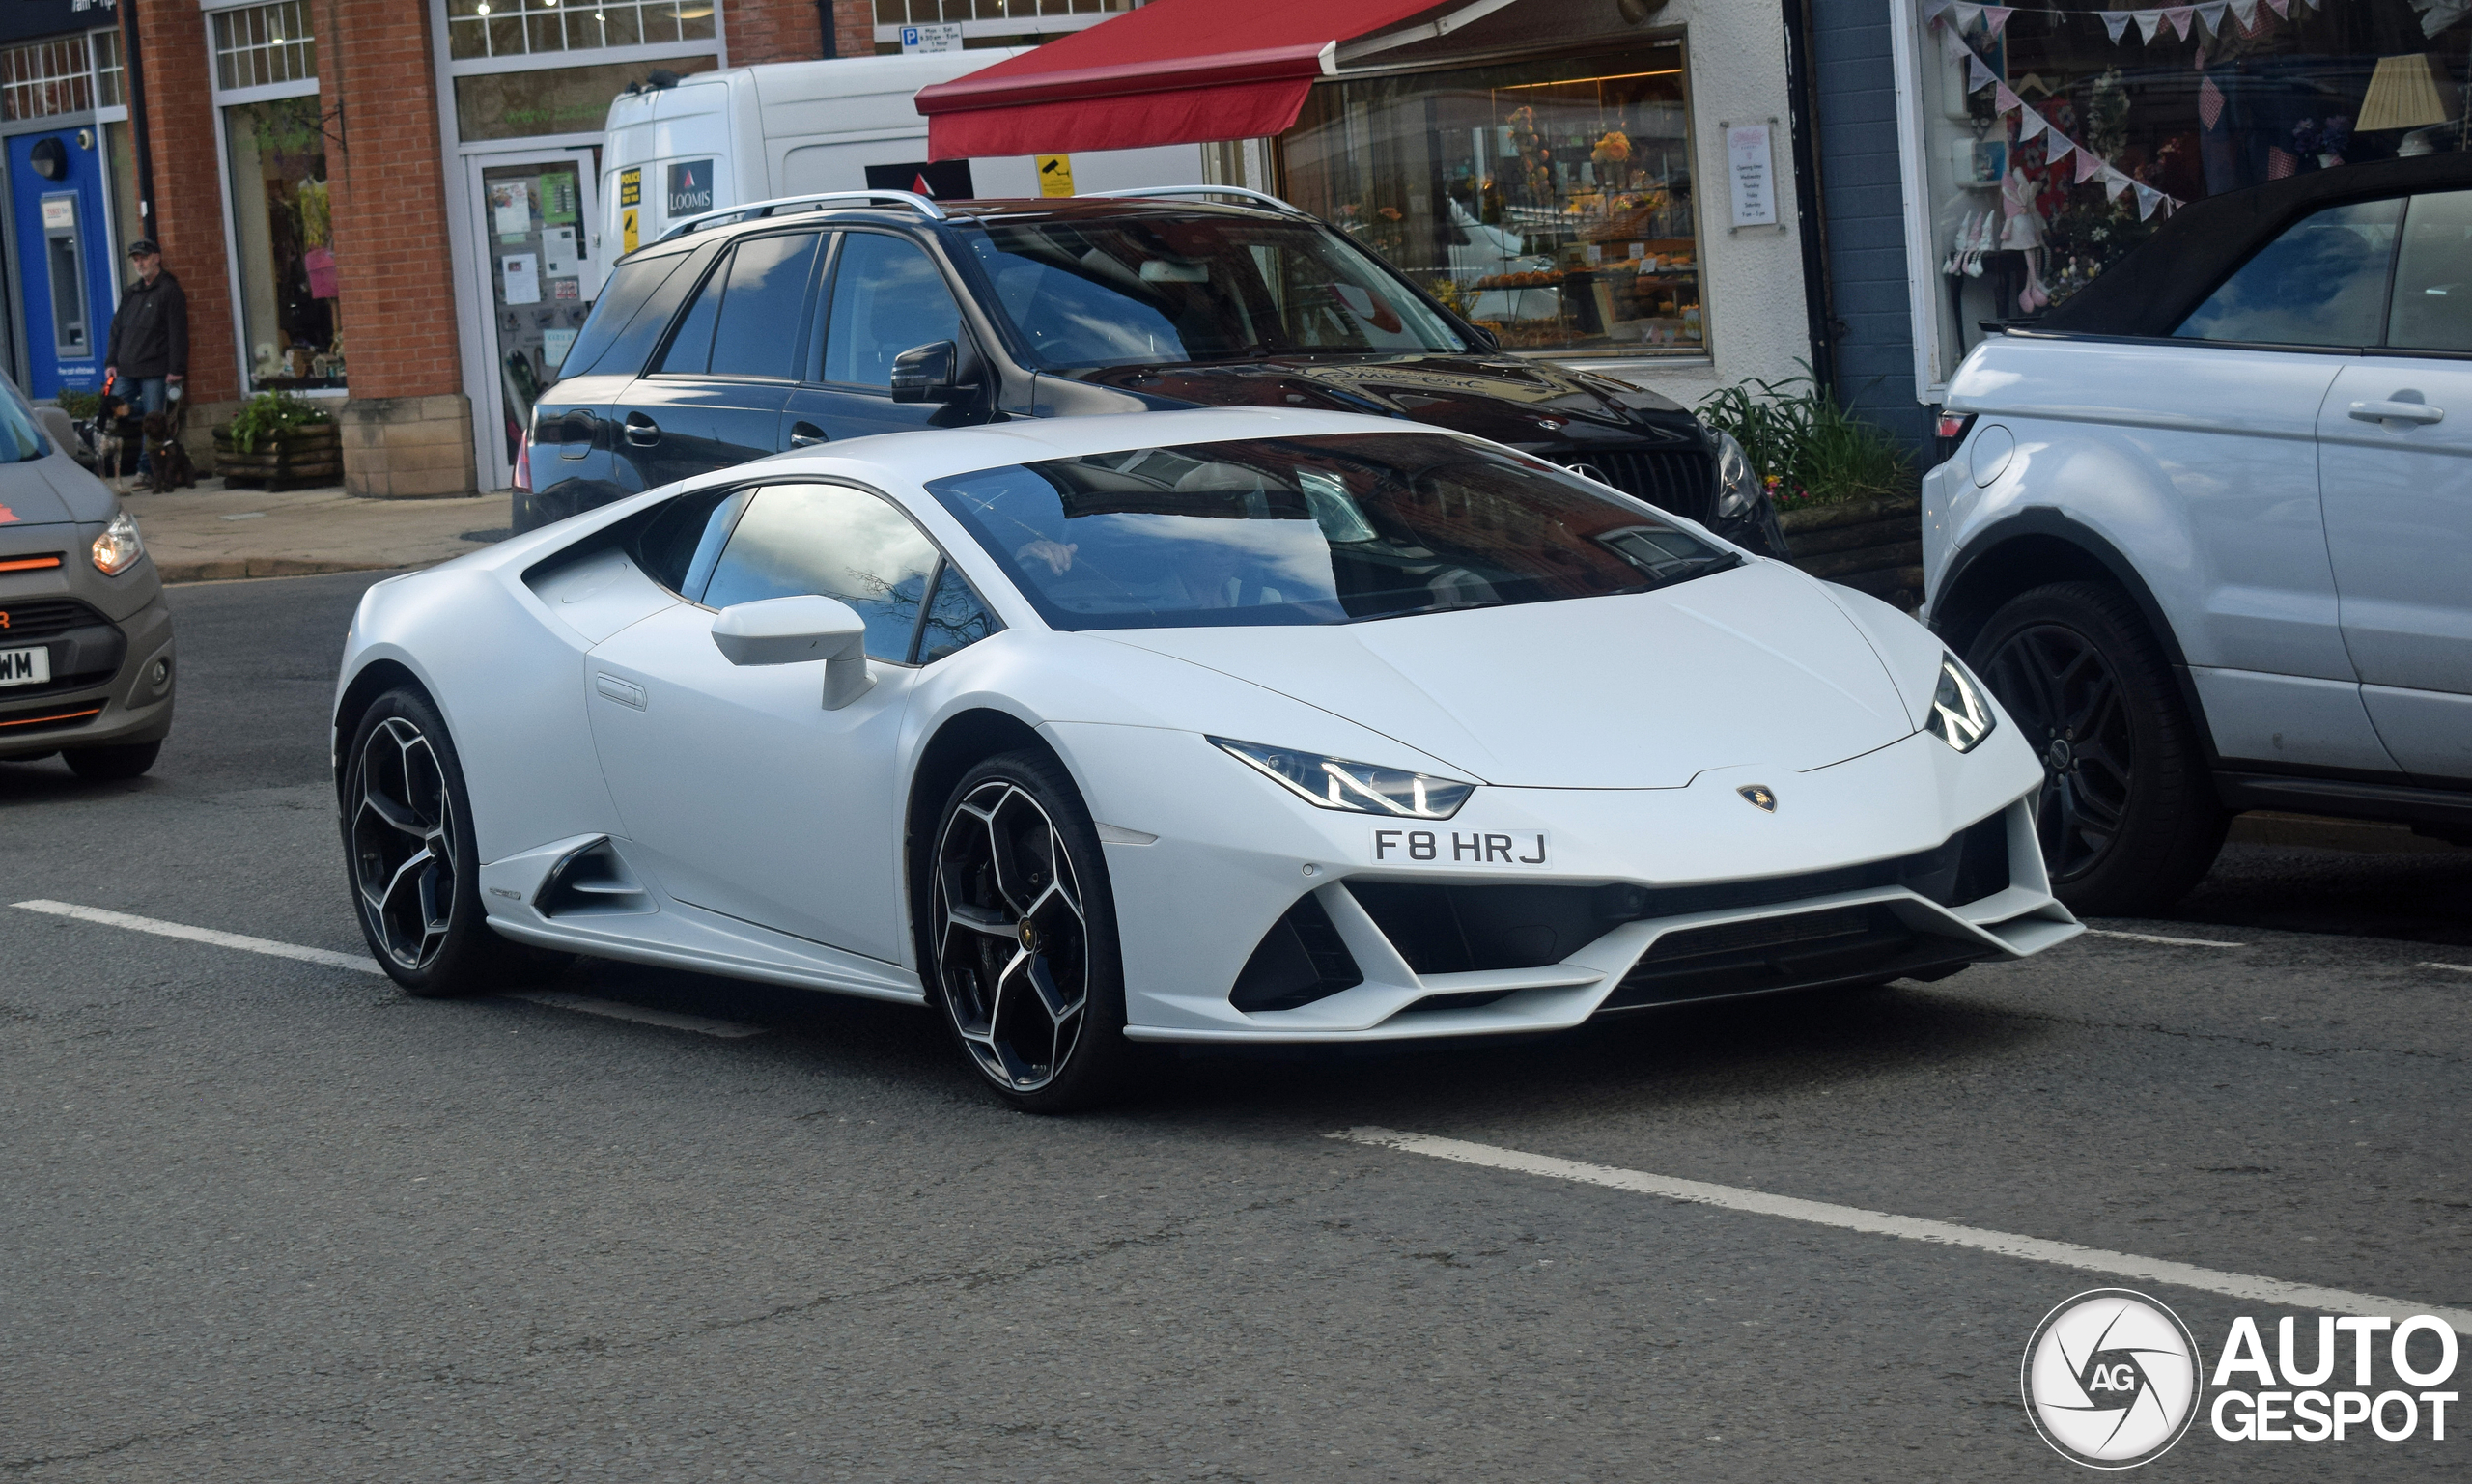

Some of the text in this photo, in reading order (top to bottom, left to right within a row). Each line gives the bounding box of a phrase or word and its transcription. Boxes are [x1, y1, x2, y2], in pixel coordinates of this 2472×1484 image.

[906, 30, 915, 44] P
[621, 171, 640, 185] POLICE
[669, 190, 711, 210] LOOMIS
[0, 652, 33, 680] WM
[1375, 829, 1546, 865] F8 HRJ
